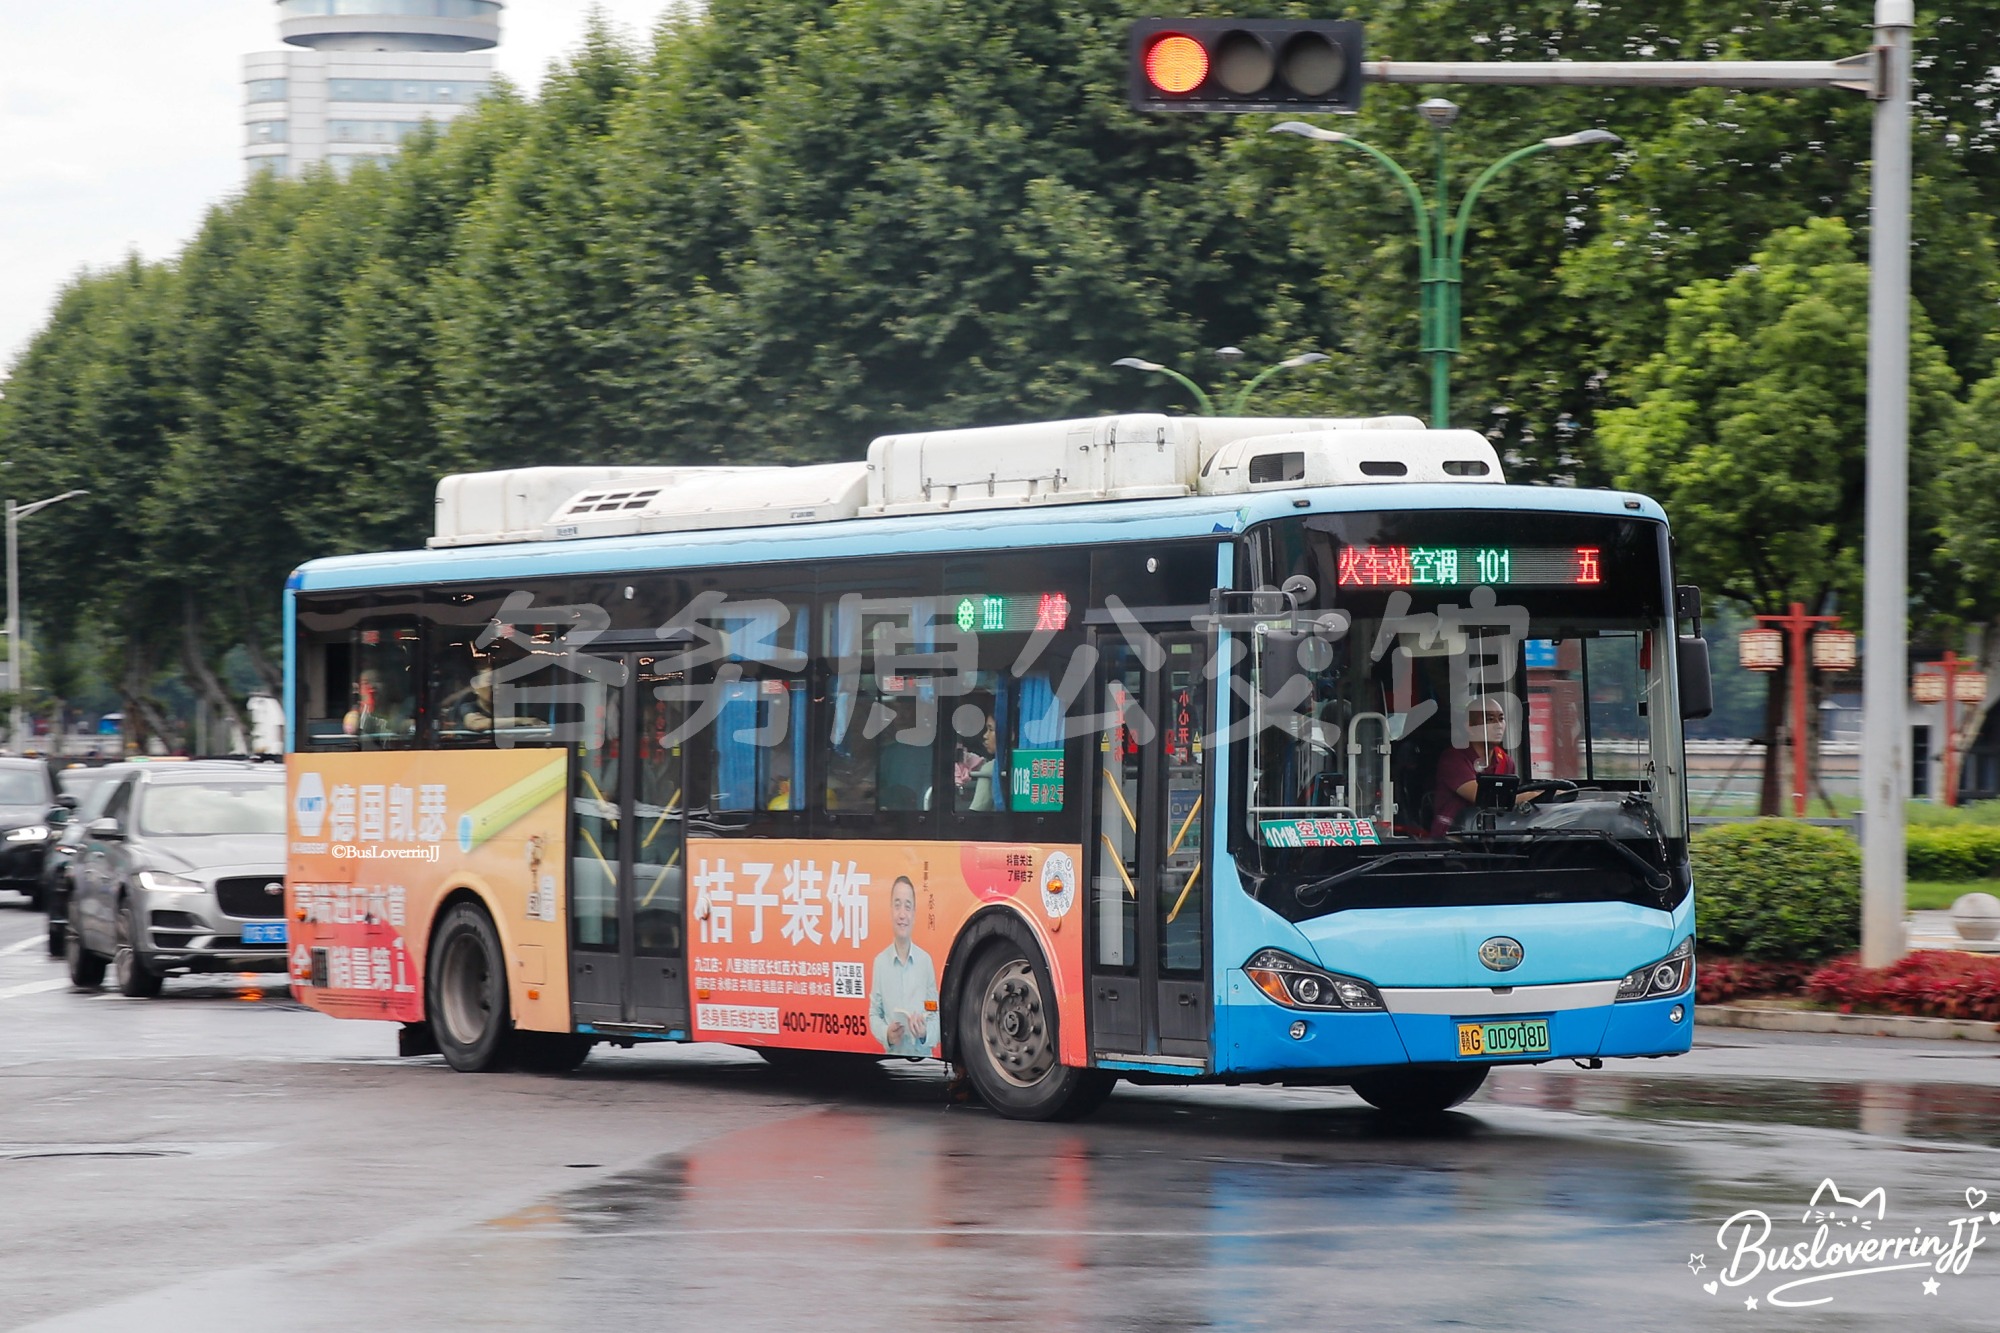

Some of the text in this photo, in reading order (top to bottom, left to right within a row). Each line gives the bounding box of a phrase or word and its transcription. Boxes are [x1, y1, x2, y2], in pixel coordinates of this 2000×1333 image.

[1476, 549, 1511, 583] 101
[1577, 548, 1600, 583] 五
[982, 598, 1004, 630] 101
[1296, 820, 1375, 838] 空调开启
[1006, 854, 1033, 867] 抖音关注
[694, 858, 871, 949] 桔子装饰
[292, 936, 410, 994] 全销量第1
[782, 1011, 868, 1037] 400-7788-985
